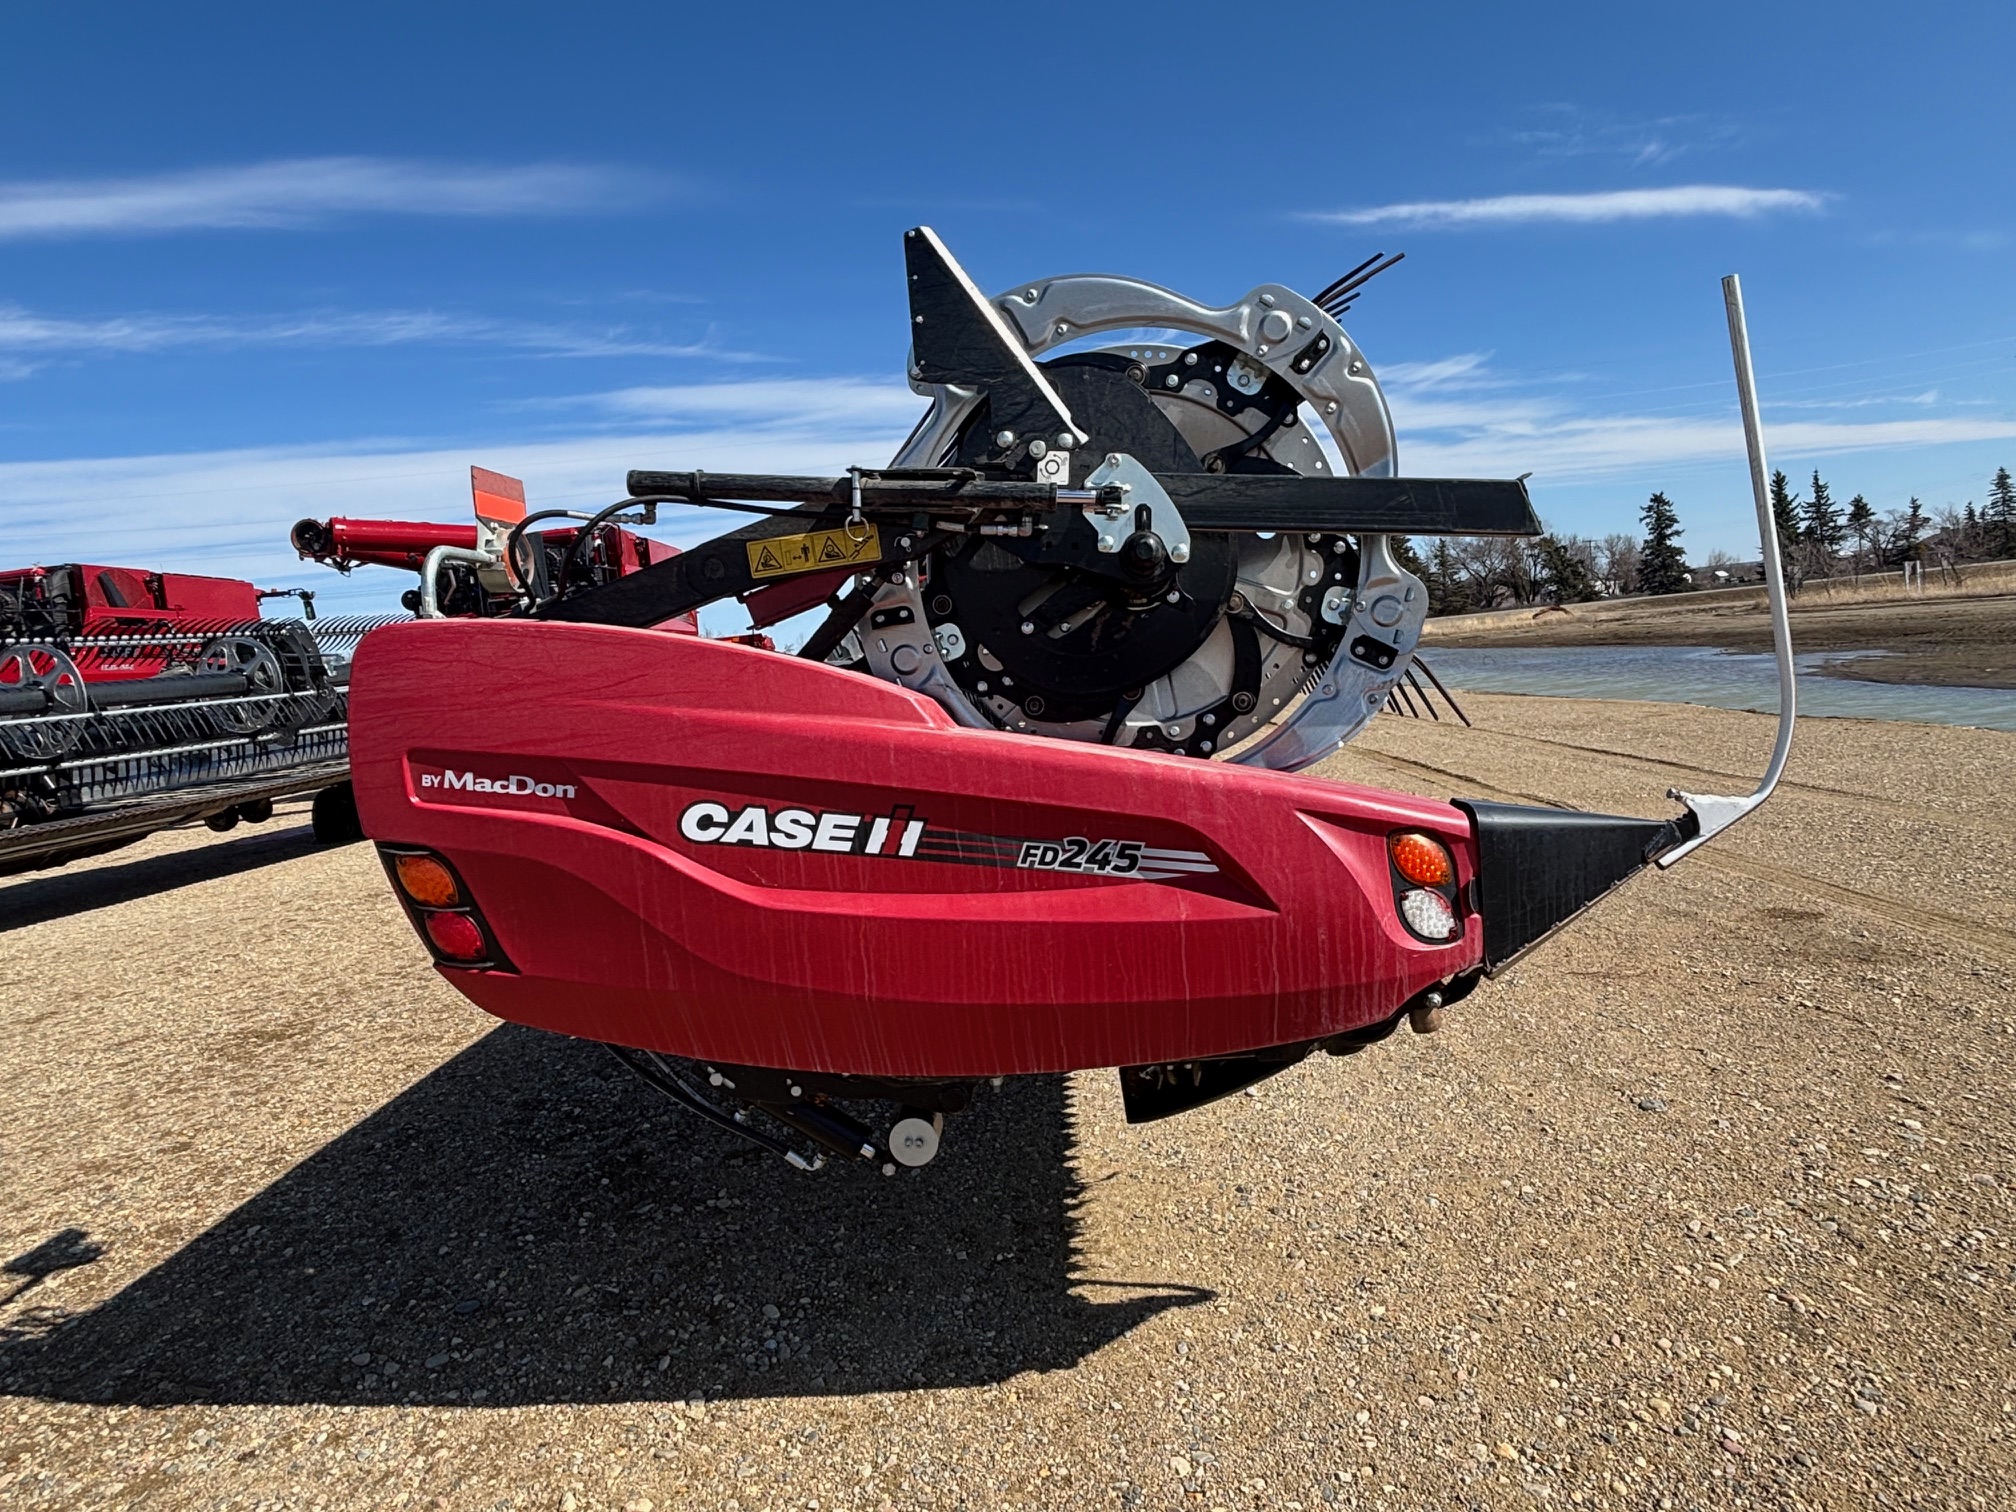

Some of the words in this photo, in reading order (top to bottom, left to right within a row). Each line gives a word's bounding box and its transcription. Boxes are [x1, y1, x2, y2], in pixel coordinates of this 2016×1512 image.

[421, 774, 441, 788] BY
[443, 769, 575, 798] MacDon
[680, 802, 862, 852] CASE
[864, 804, 925, 857] IH
[1017, 836, 1146, 875] FD245
